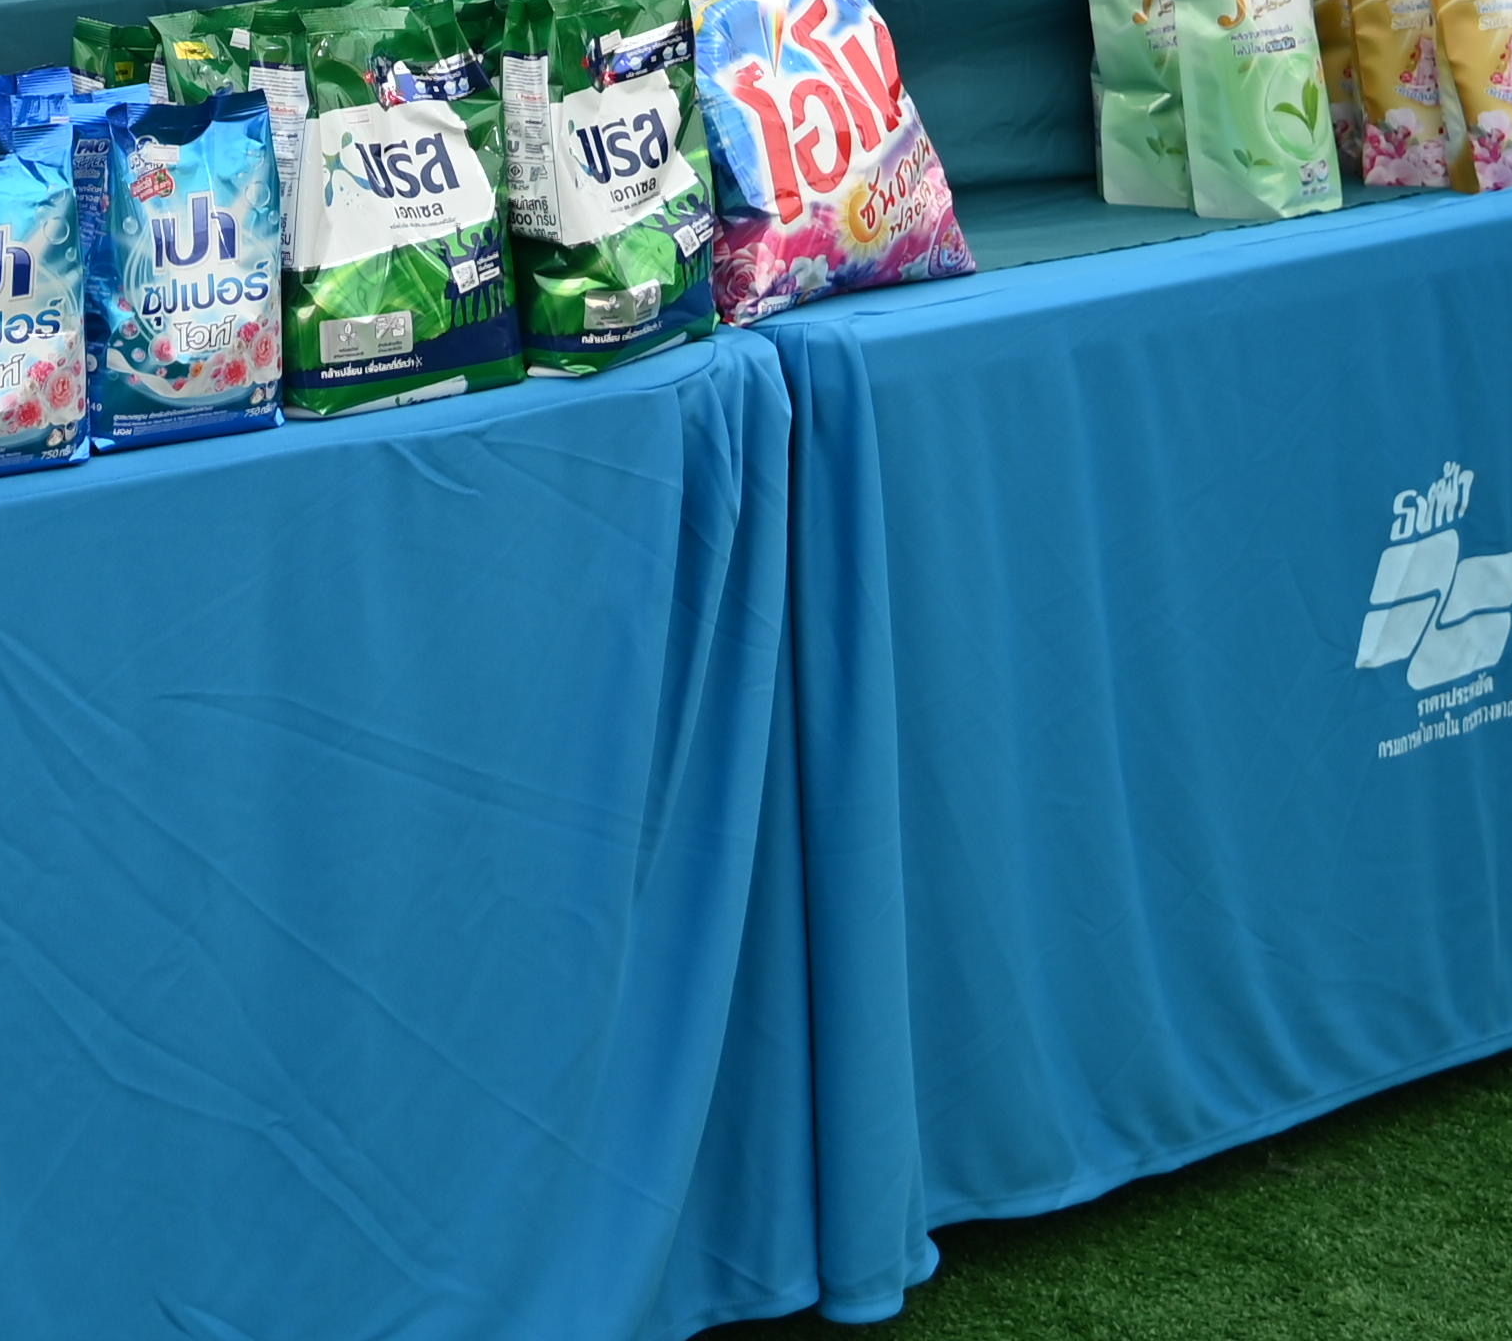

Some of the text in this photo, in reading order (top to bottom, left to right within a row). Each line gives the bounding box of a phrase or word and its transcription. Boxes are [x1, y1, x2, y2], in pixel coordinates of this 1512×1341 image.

[1389, 460, 1475, 542] ธงฟ้า
[1417, 671, 1494, 717] ราคาประหยัด
[1378, 716, 1460, 759] กรมการค้าภายใน
